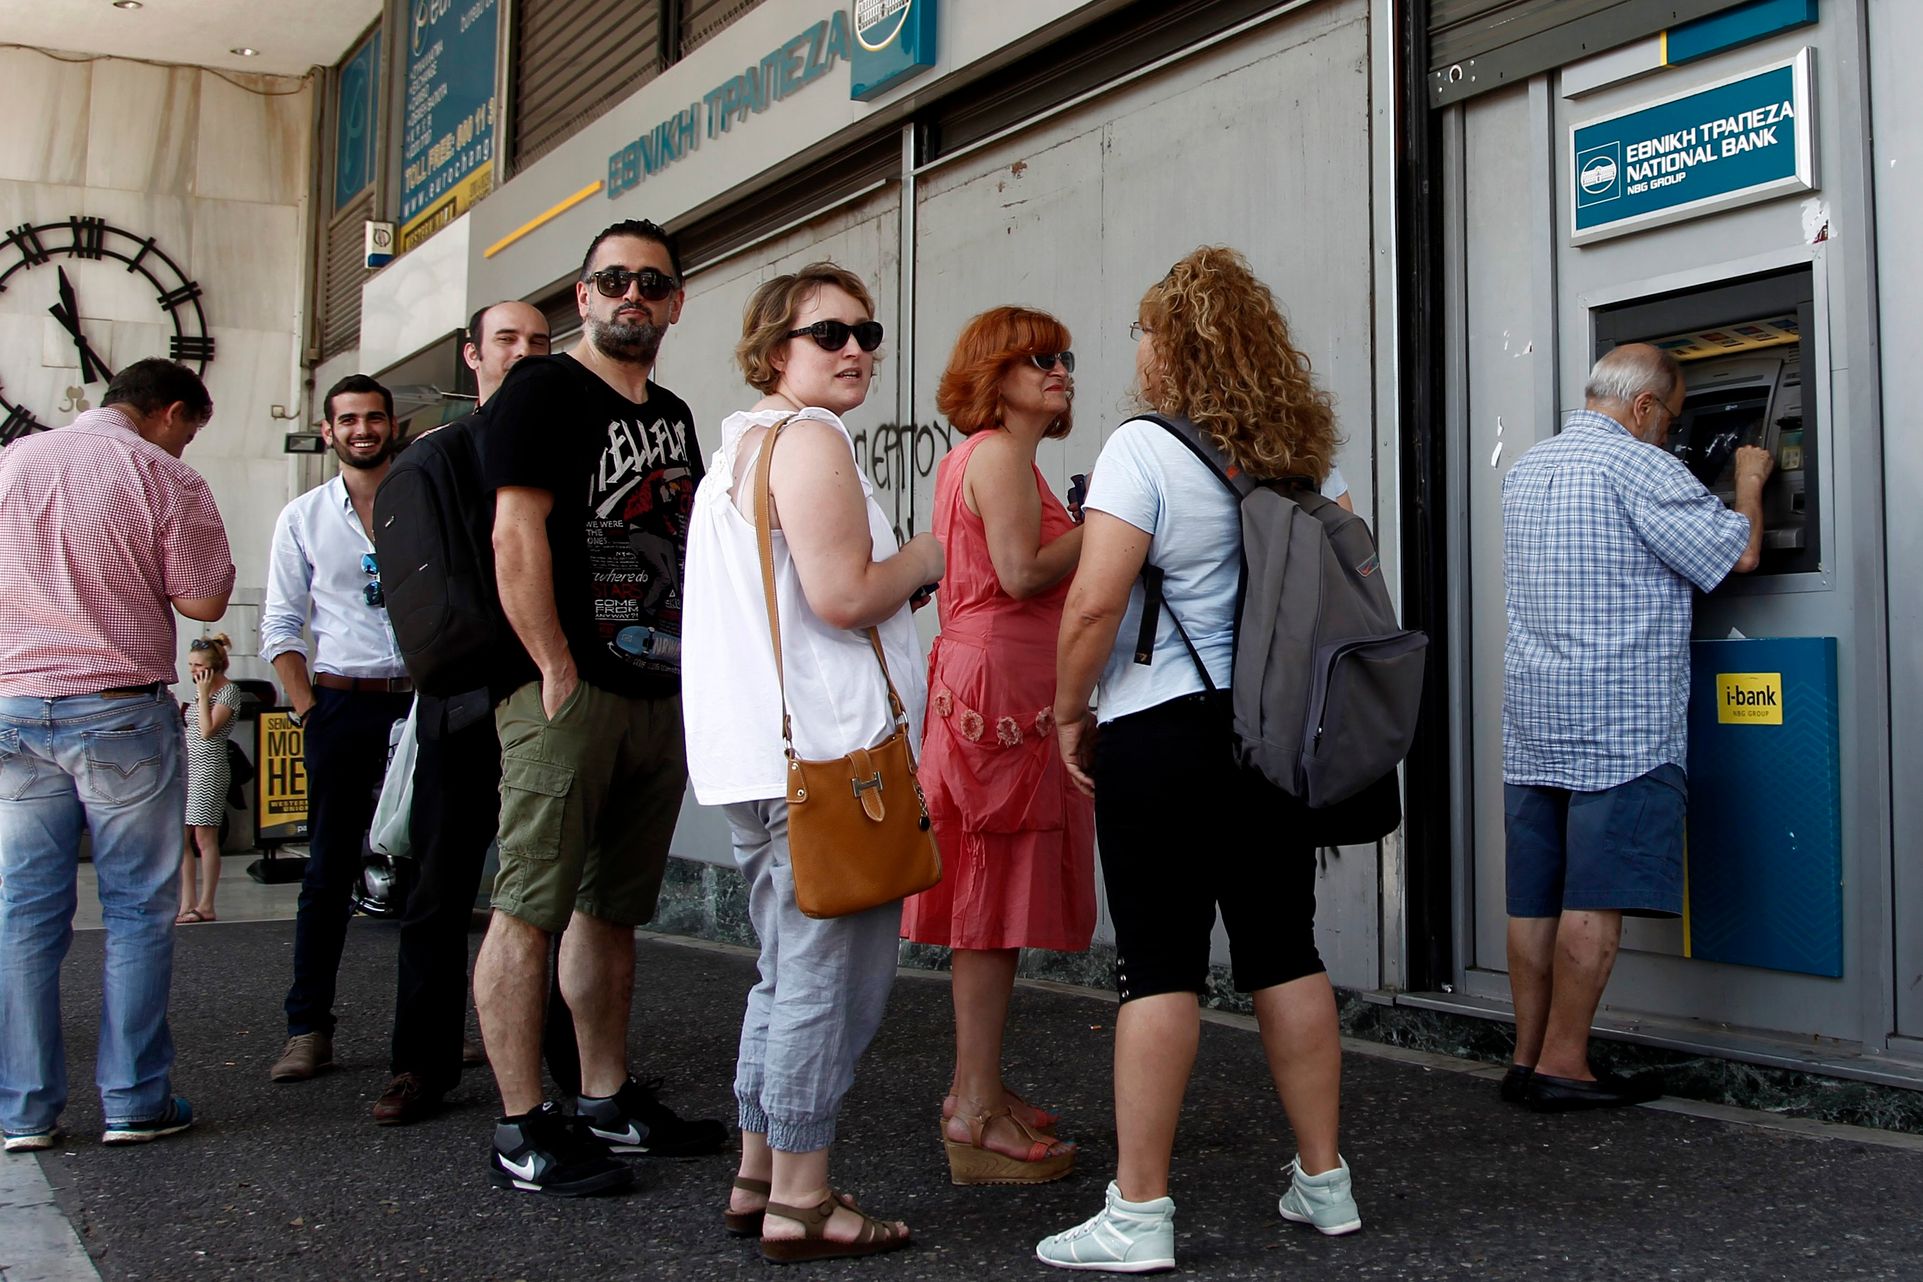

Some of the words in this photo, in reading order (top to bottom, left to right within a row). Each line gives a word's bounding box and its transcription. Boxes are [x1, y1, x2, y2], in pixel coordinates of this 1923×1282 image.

[607, 102, 702, 199] ΕΘΝΙΚΗ
[703, 10, 852, 139] ΤΡΑΠΕΖΑ
[1626, 128, 1697, 163] ΕΘΝΙΚΗ
[1699, 101, 1795, 142] ΤΡΑΠΕΖΑ
[1626, 144, 1718, 183] NATIONAL
[1722, 126, 1778, 158] BANK
[1627, 182, 1648, 196] NBG
[1650, 171, 1686, 190] GROUP
[585, 528, 603, 536] THE
[600, 520, 624, 528] WERE
[594, 599, 637, 607] COME
[595, 606, 639, 614] FROM
[1727, 685, 1777, 706] i-bank
[268, 718, 293, 730] SEND
[268, 731, 305, 757] MO
[268, 757, 305, 796] HE
